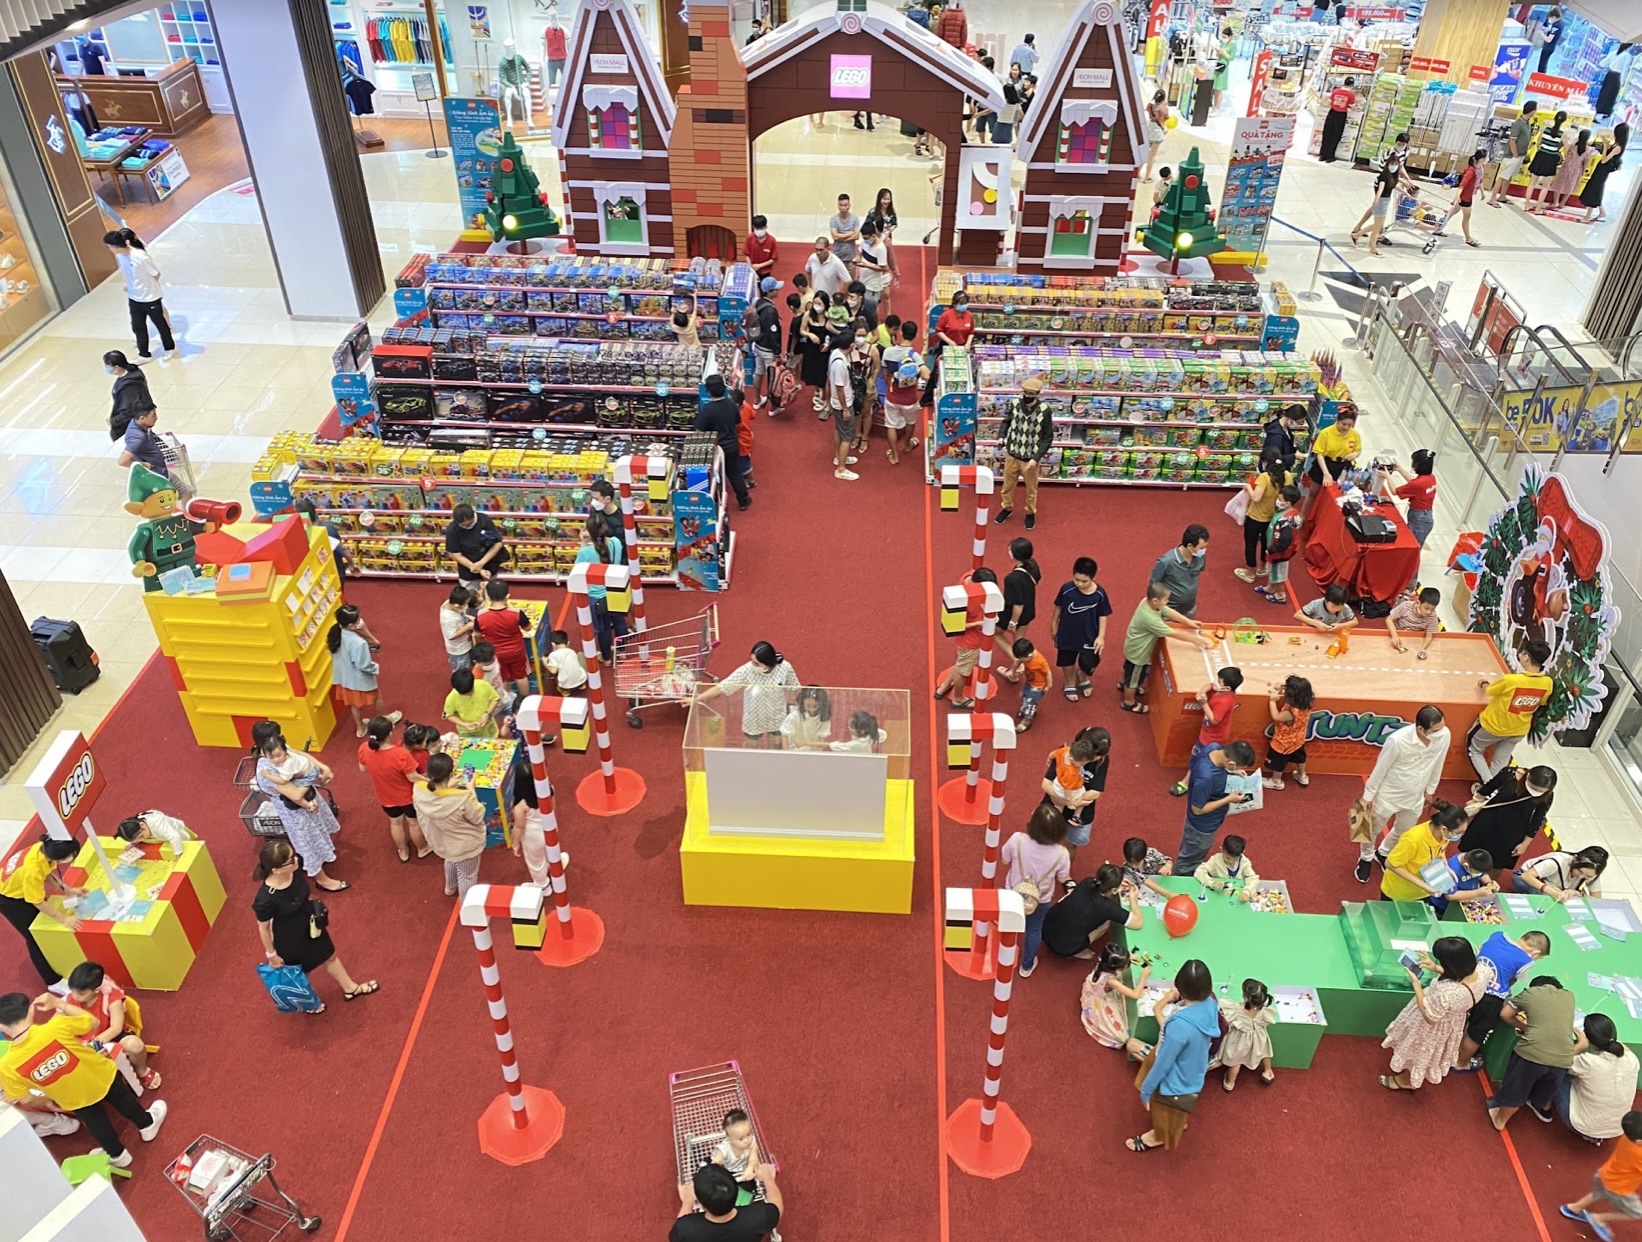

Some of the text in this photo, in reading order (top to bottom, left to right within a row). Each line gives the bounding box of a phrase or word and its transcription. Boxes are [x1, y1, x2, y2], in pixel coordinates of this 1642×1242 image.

[832, 67, 869, 86] LEGO
[1505, 400, 1519, 421] be
[1512, 695, 1541, 708] LEGO
[58, 751, 94, 819] LEGO
[31, 1049, 69, 1081] LEGO
